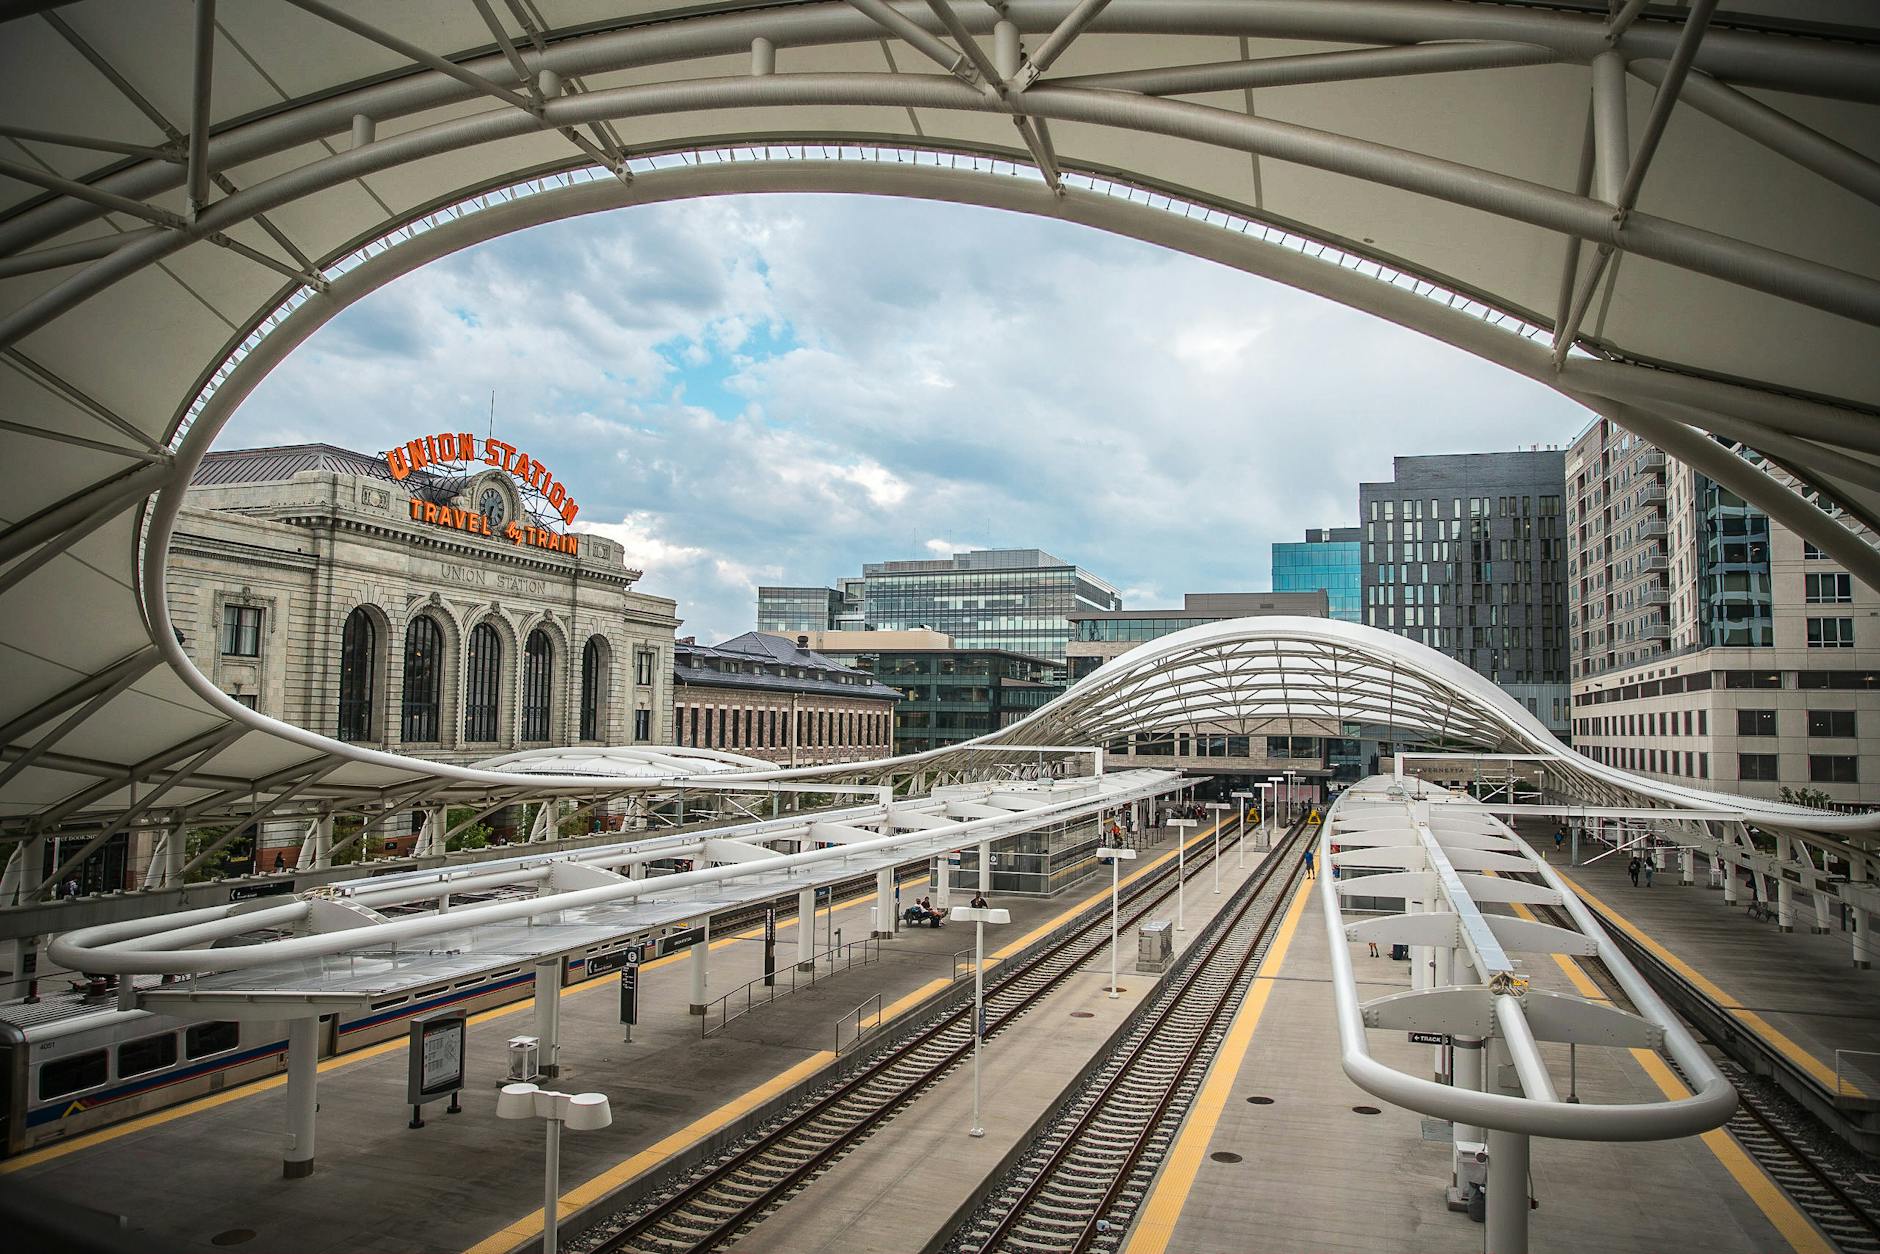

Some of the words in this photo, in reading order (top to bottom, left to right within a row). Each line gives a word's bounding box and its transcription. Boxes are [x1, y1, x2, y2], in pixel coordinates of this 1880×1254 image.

[387, 432, 475, 480] UNION
[484, 438, 579, 525] STATION
[409, 497, 492, 536] TRAVEL
[506, 520, 523, 545] by
[525, 526, 579, 555] TRAIN
[441, 564, 486, 585] UNION
[497, 575, 546, 595] STATION
[1420, 1035, 1441, 1043] TRACK
